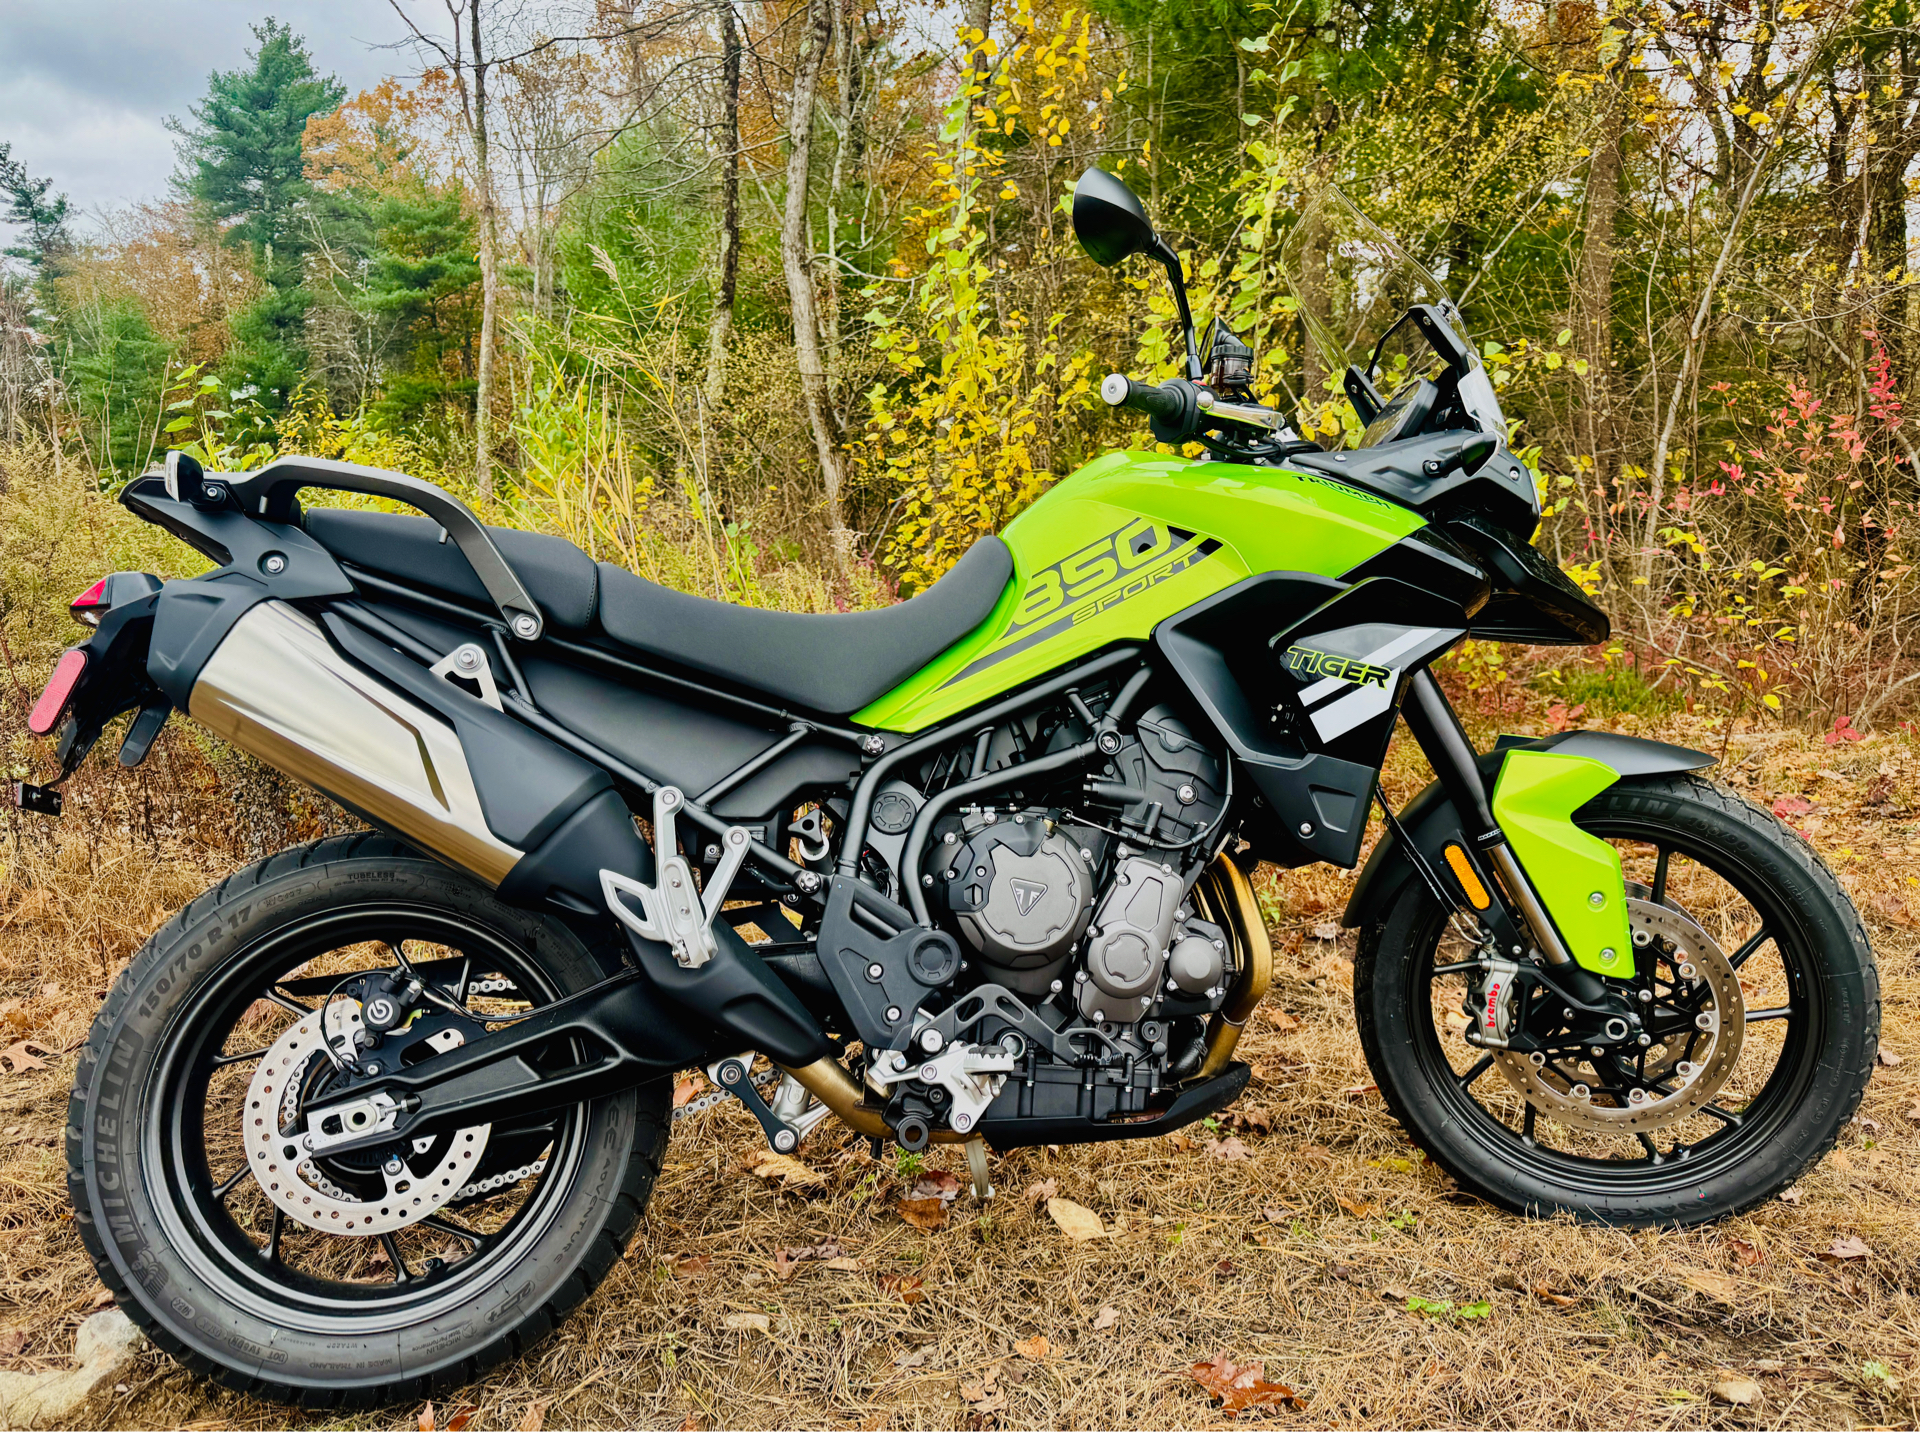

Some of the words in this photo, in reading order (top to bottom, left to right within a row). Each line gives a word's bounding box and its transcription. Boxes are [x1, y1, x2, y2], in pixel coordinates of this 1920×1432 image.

[1292, 475, 1391, 510] TRIUMPH
[1013, 518, 1171, 626] 850
[1072, 549, 1198, 625] SPORT
[1286, 645, 1392, 690] TIGER
[347, 871, 394, 881] TUBELESS
[1484, 983, 1502, 1028] brembo
[96, 1040, 140, 1244] MICHELIN
[137, 944, 203, 1020] 150/70
[205, 927, 224, 942] R
[227, 904, 252, 927] 17
[553, 1157, 611, 1264] ADVENTURE
[265, 1349, 286, 1362] DOT
[424, 1334, 463, 1354] MICHELIN
[307, 1360, 352, 1369] THAILAND
[355, 1360, 365, 1369] IN
[367, 1357, 393, 1368] MADE
